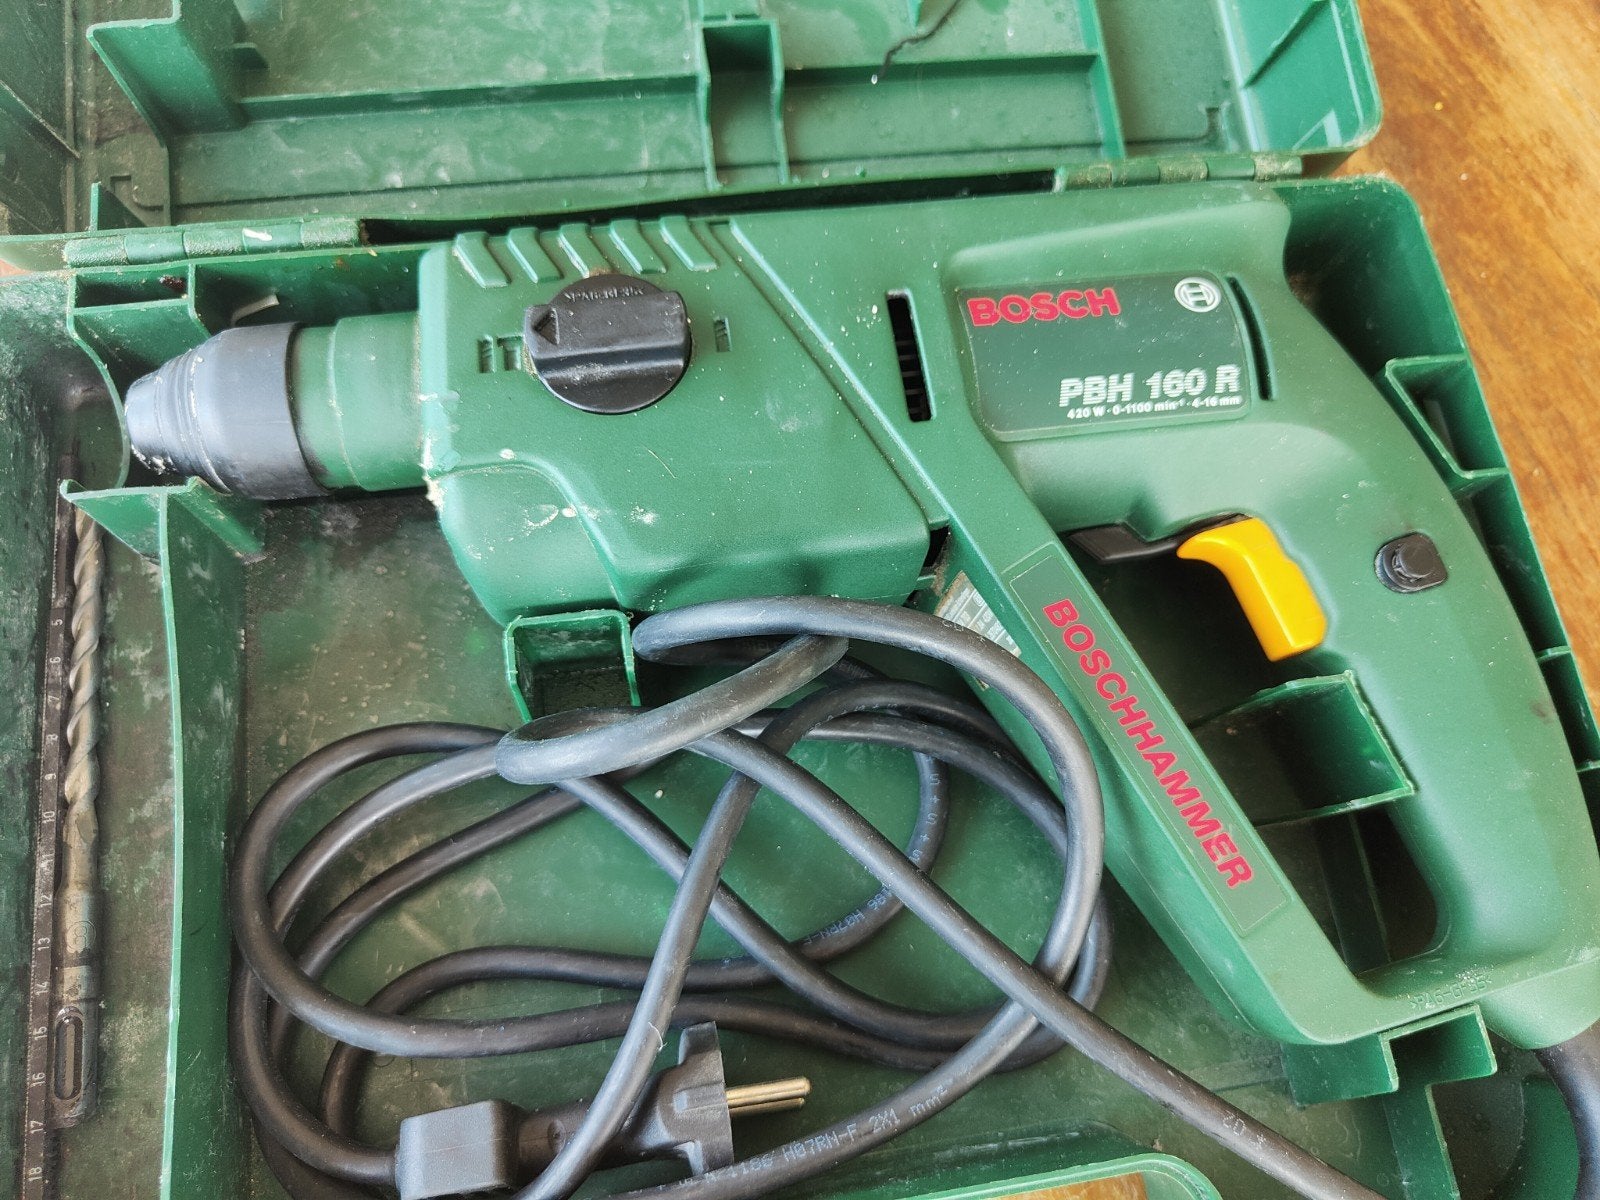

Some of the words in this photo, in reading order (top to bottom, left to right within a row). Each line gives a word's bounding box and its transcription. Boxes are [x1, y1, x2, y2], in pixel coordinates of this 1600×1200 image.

[967, 287, 1121, 327] BOSCH
[1059, 373, 1134, 407] PBH
[1144, 367, 1208, 399] 160
[1214, 363, 1241, 394] R
[1066, 407, 1091, 420] 420
[1092, 405, 1107, 417] W
[1112, 402, 1151, 416] 0-1100
[1191, 395, 1218, 409] 4-16
[1218, 394, 1241, 406] mm
[52, 618, 63, 627] 5
[50, 656, 62, 665] 6
[46, 734, 58, 742] 8
[1042, 598, 1253, 889] BOSCHHAMMER
[44, 772, 57, 781] 9
[43, 811, 55, 824] 10
[40, 895, 53, 908] 12
[37, 937, 50, 951] 13
[35, 981, 49, 996] 14
[34, 1026, 47, 1041] 15
[32, 1072, 45, 1087] 16
[30, 1120, 43, 1134] 17
[782, 1123, 857, 1163] H07RN-F
[28, 1166, 42, 1182] 18
